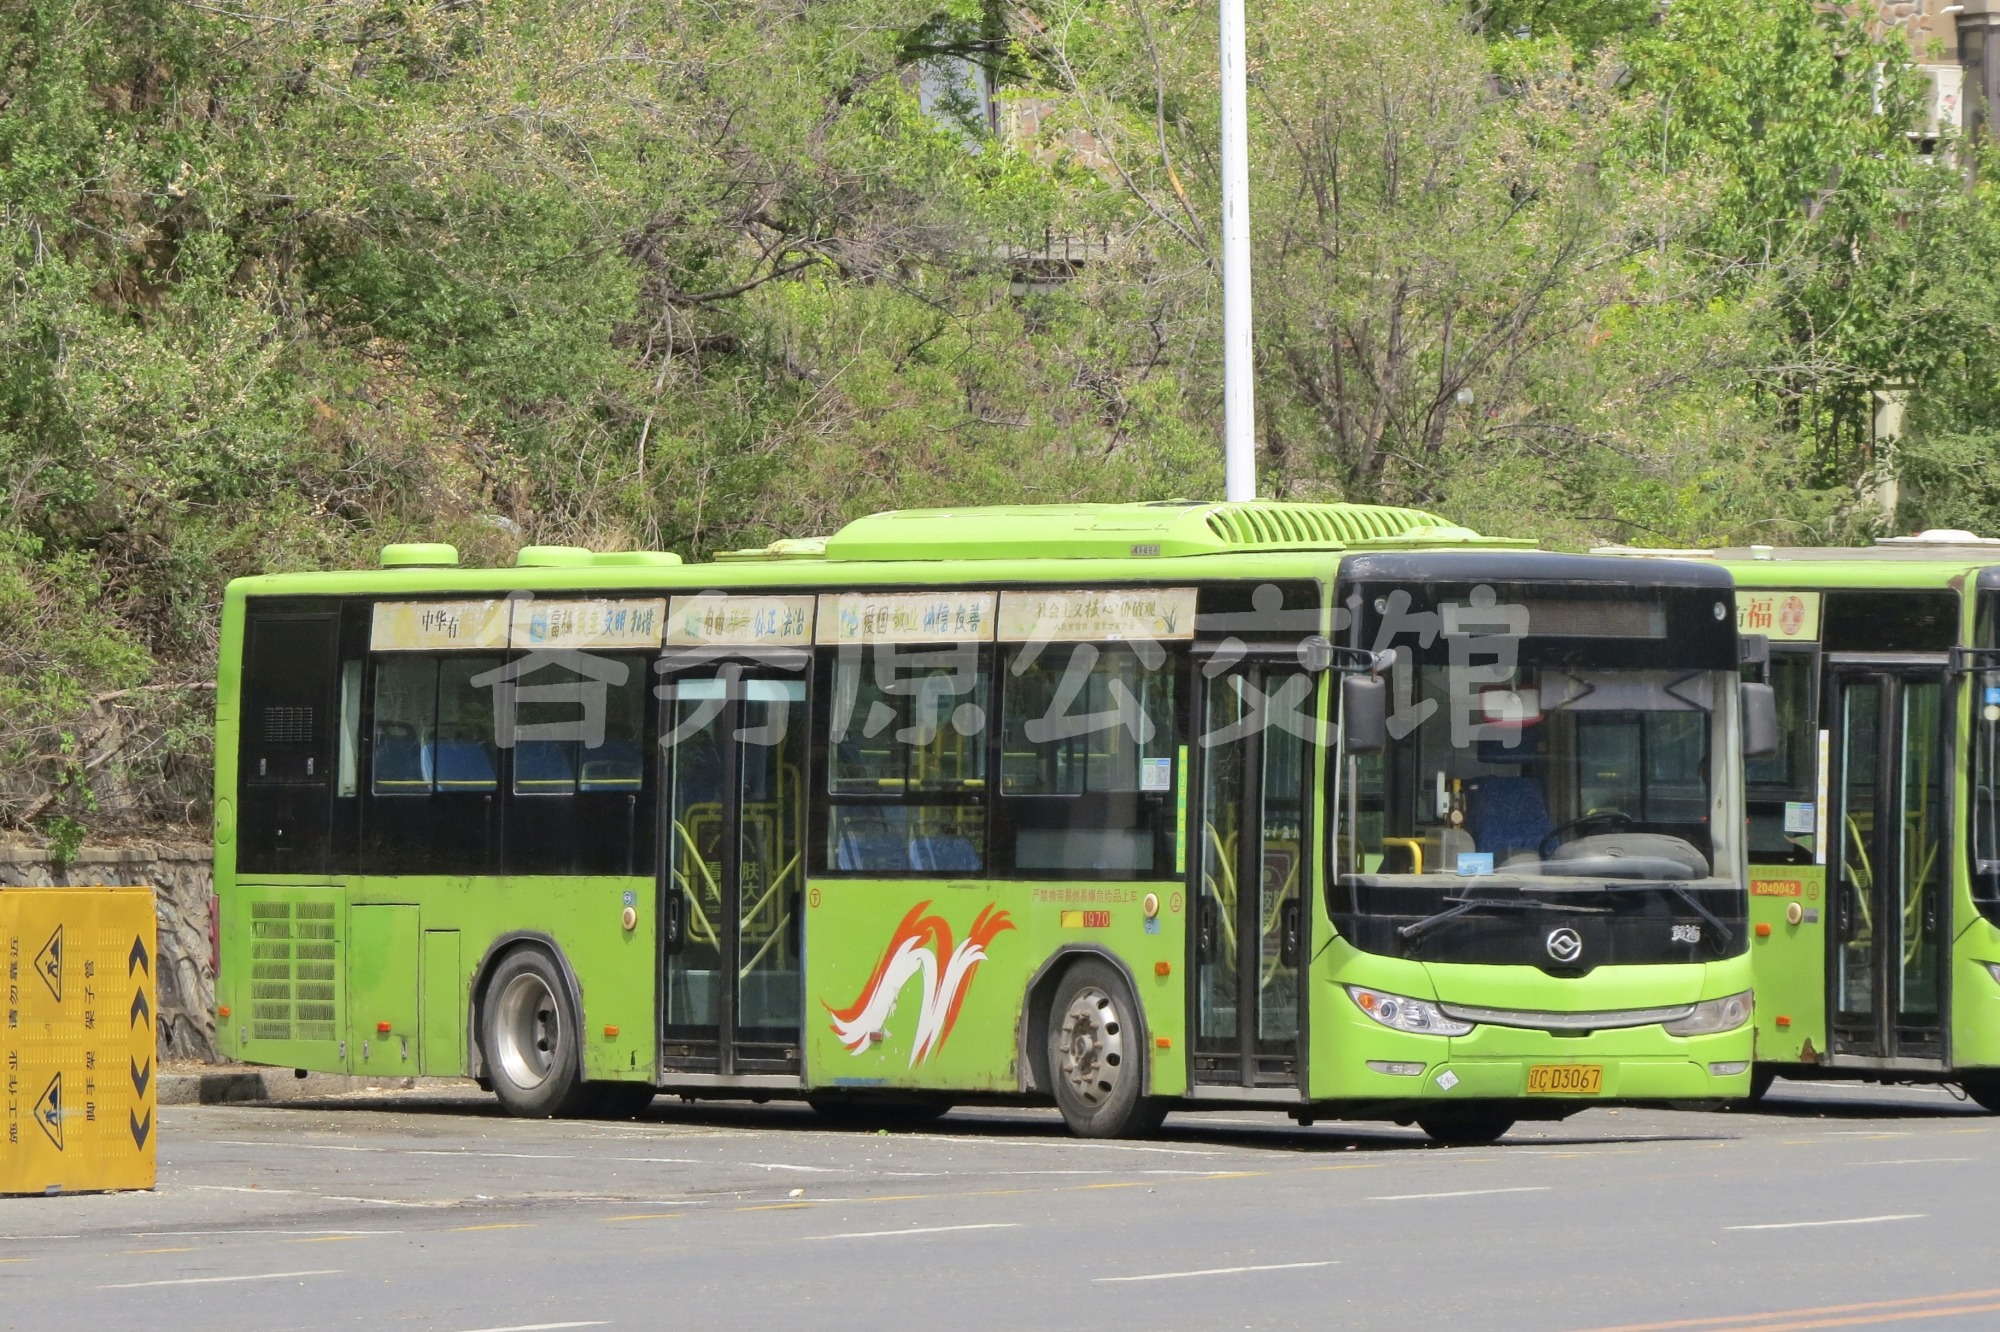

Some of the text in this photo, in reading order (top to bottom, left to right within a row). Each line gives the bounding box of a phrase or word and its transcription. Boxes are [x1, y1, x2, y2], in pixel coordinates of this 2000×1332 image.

[551, 608, 655, 638] 富强 民主 文明 和谐
[705, 606, 805, 637] 自由 平等 公正 法治
[863, 603, 981, 635] 爱国 敬业 诚信 友善
[1037, 599, 1156, 618] 社会主义核心价值观
[1756, 882, 1796, 895] 2040042
[1084, 911, 1110, 927] 1970
[8, 935, 19, 1145] 施工作业 请勿靠近
[84, 959, 96, 1122] 脚手架 架子管
[1440, 1075, 1456, 1086] LNG
